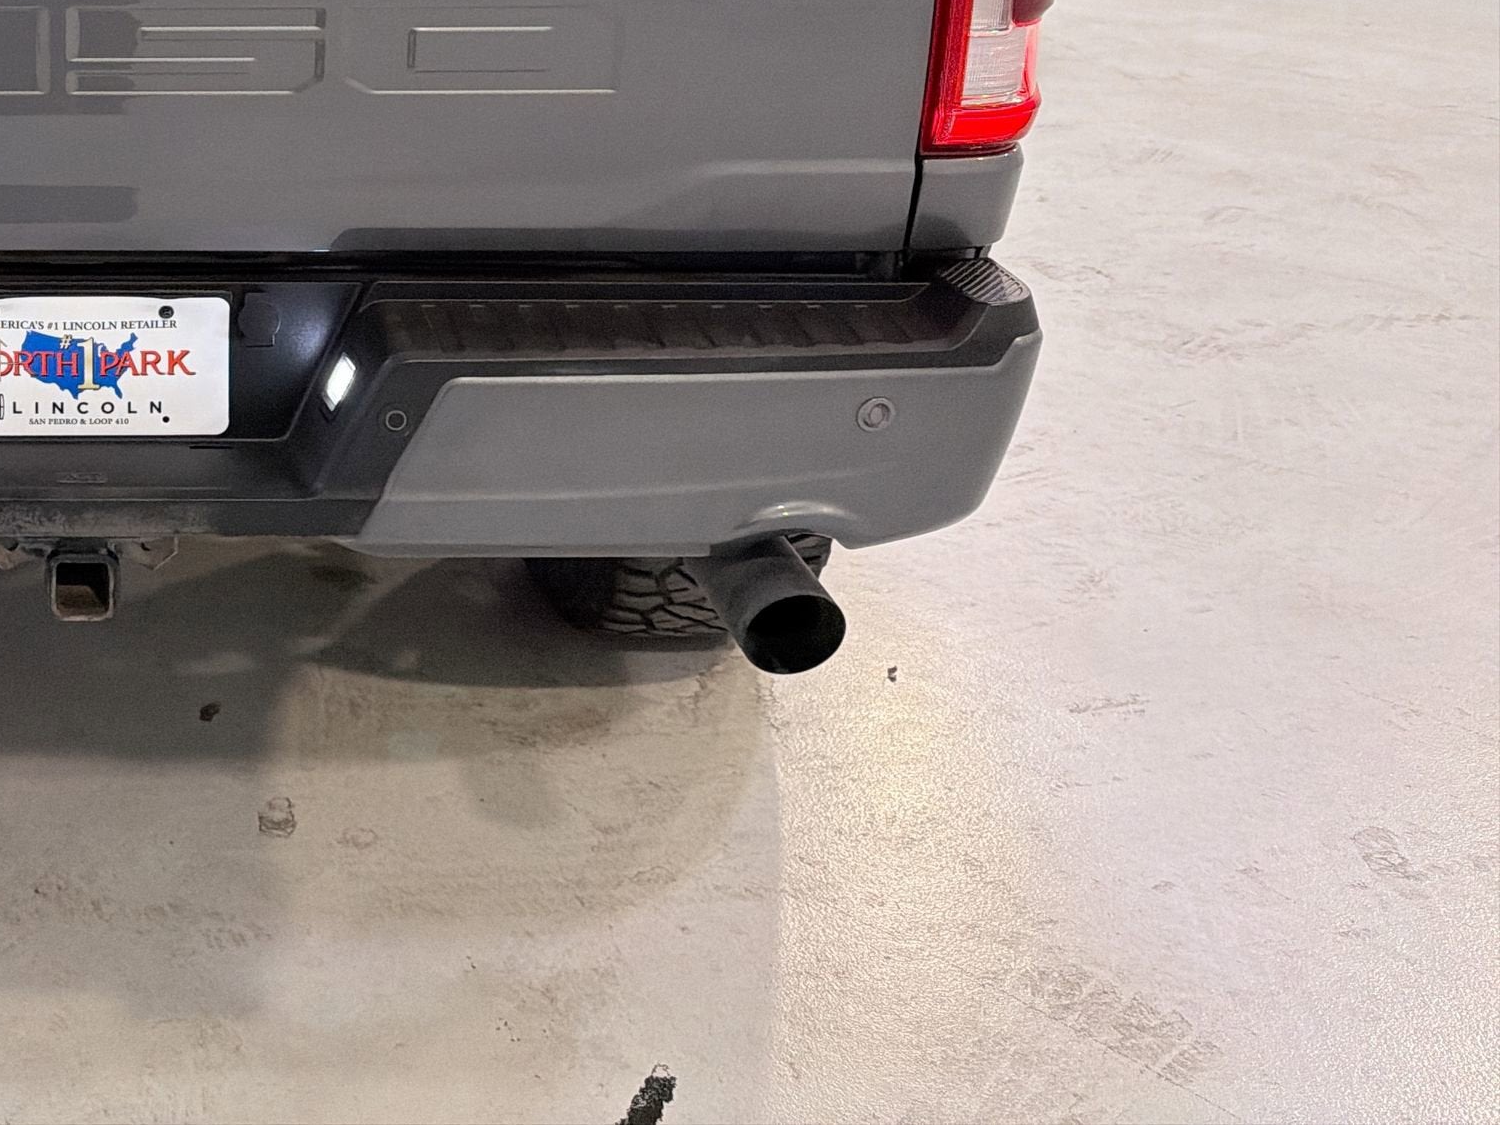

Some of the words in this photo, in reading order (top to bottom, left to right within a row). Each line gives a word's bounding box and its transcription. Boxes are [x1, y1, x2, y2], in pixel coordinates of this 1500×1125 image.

[47, 321, 59, 331] #1
[62, 320, 117, 331] LINCOLN
[121, 319, 177, 330] RETAILER
[99, 349, 196, 376] PARK
[12, 401, 162, 414] LINCOLN
